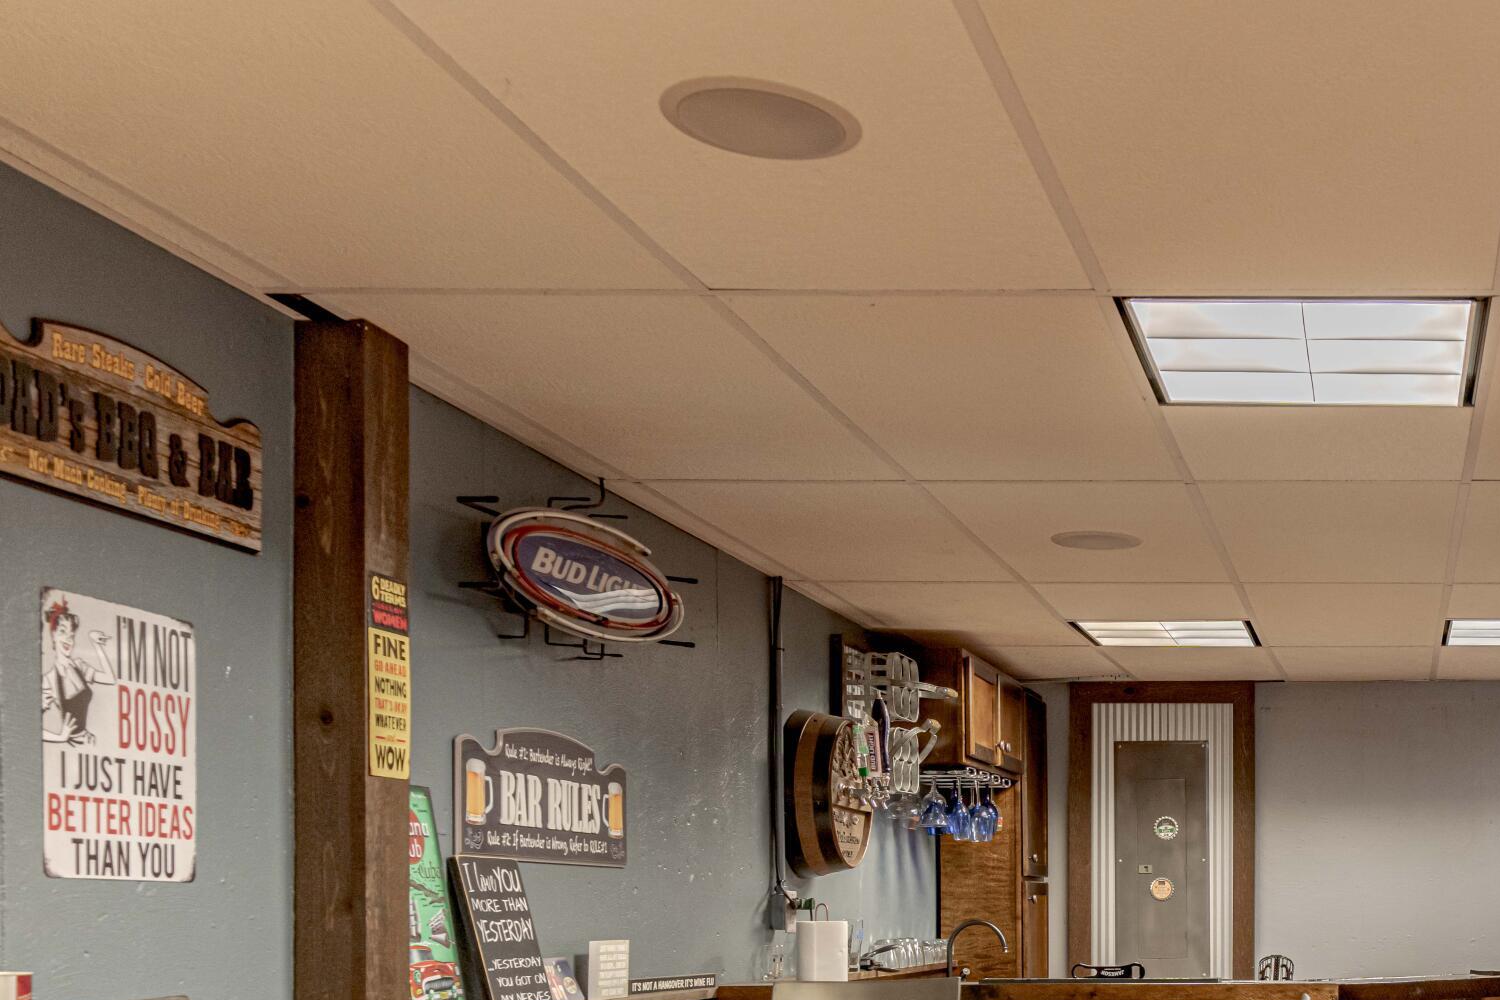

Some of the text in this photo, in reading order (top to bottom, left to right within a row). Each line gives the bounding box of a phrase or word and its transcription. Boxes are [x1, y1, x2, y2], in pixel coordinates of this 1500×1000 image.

[52, 333, 86, 364] Rare
[92, 343, 135, 380] Steaks
[144, 365, 172, 397] Cold
[93, 391, 158, 479] BBQ
[168, 433, 190, 487] &
[198, 432, 253, 511] BAR
[531, 546, 586, 584] BUD
[380, 578, 406, 596] DEADLY
[380, 591, 406, 608] TERMS
[373, 609, 408, 632] WOMEN
[116, 615, 192, 692] I'M NOT
[374, 634, 406, 661] FINE
[374, 676, 407, 699] NOTHING
[118, 684, 191, 757] BOSSY
[375, 713, 407, 731] WHATEVER
[374, 743, 406, 772] WOW
[61, 751, 183, 800] I JUST HAVE
[47, 793, 193, 840] BETTER IDEAS
[500, 770, 601, 834] BAR RULES
[71, 838, 175, 879] THAN YOU
[462, 863, 475, 893] I
[492, 866, 522, 893] YOU
[471, 896, 529, 912] MORE THAN
[476, 917, 535, 943] YESTERDAY
[496, 972, 547, 987] YOU GOT ON
[631, 982, 641, 993] IT'S
[642, 981, 653, 991] NOT
[658, 979, 685, 990] HANGOVER
